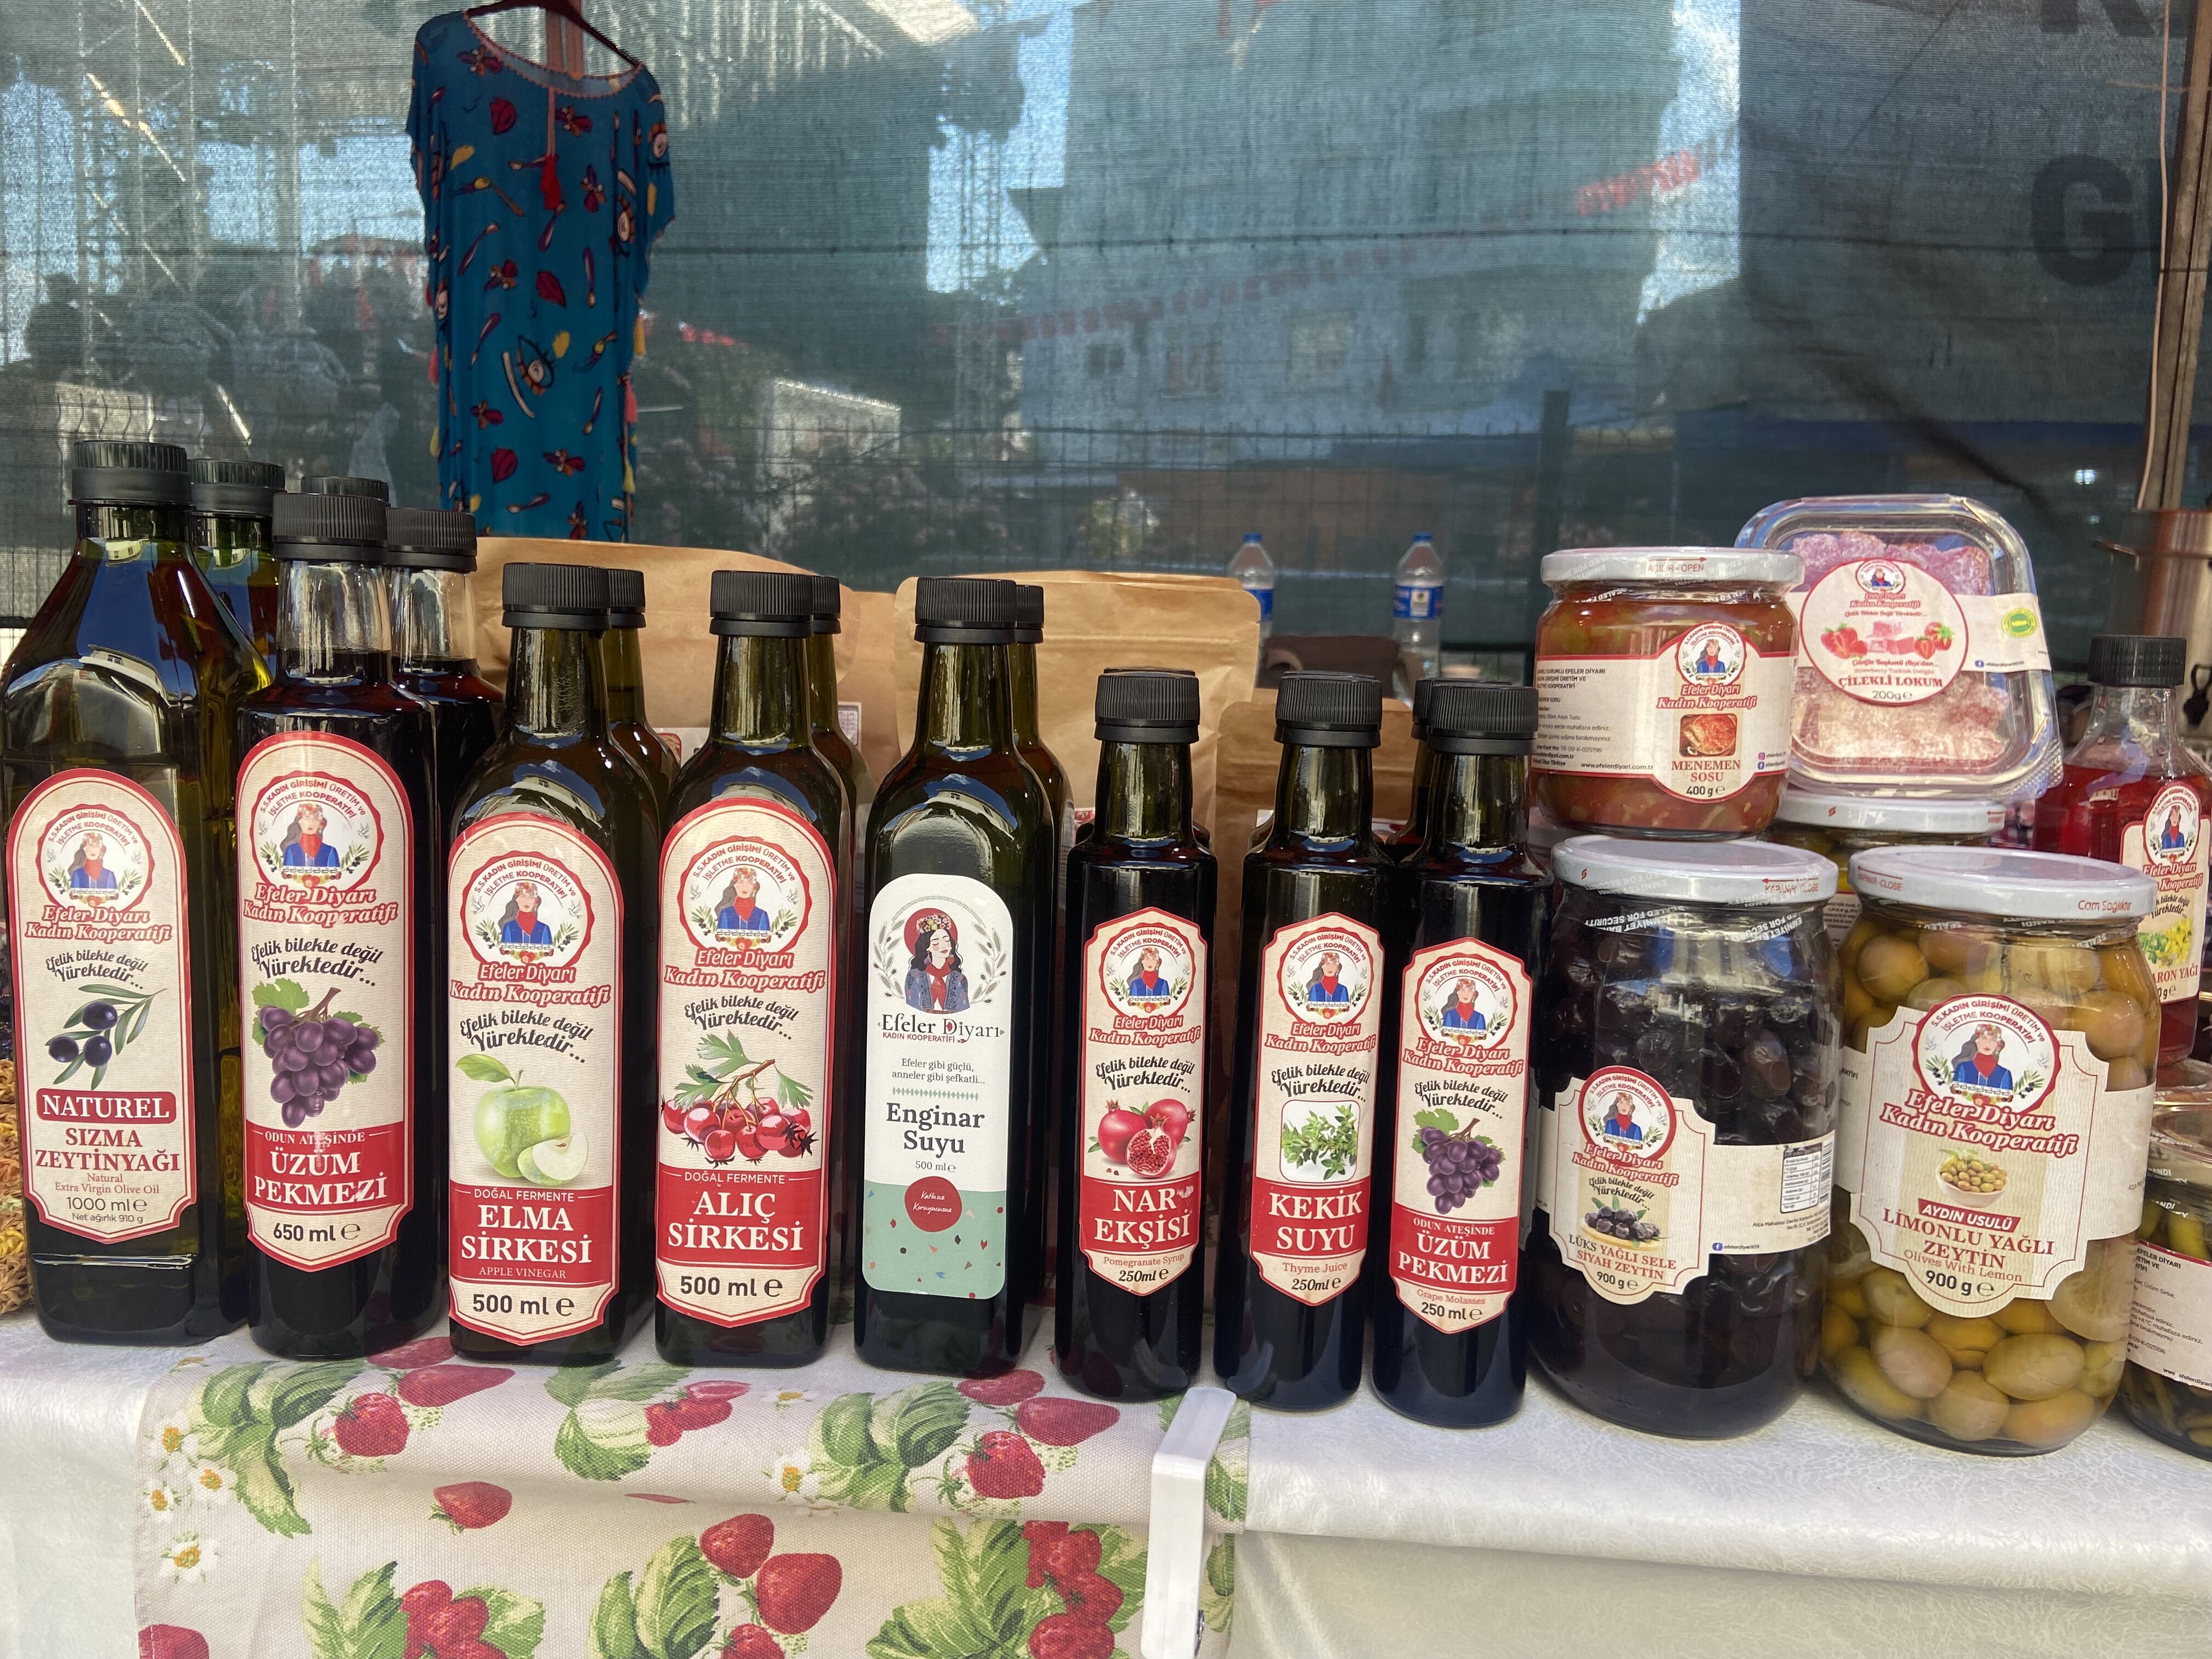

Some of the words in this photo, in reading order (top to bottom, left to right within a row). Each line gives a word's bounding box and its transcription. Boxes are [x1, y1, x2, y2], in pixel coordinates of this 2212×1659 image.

[1838, 675, 1892, 690] ÇİLEKLİ
[1896, 678, 1943, 687] LOKUM
[1671, 760, 1741, 771] MENEMEN
[1690, 772, 1724, 782] SOSU
[1686, 786, 1705, 795] 400
[2171, 862, 2197, 876] Diyarı
[2160, 873, 2203, 893] Kooperatifi
[42, 905, 92, 922] Efeler
[93, 906, 150, 926] Diyarı
[25, 922, 73, 939] Kadın
[75, 924, 172, 944] Kooperatifi
[46, 951, 74, 972] Efelik
[76, 950, 114, 961] bilekte
[116, 954, 149, 972] değil
[478, 961, 525, 981] Efeler
[526, 962, 576, 985] Diyarı
[2179, 963, 2198, 981] YAĞI
[450, 980, 503, 1002] Kadın
[504, 984, 612, 1008] Kooperatifi
[882, 1013, 936, 1034] Efeler
[943, 1018, 1000, 1042] Diyarı
[1114, 1015, 1148, 1030] Efeler
[1149, 1015, 1183, 1032] Diyarı
[1942, 1012, 1978, 1032] İŞLETME
[1980, 1011, 2036, 1044] KOOPERATİFİ
[1971, 1000, 2011, 1012] GİRİŞİMİ
[2011, 1007, 2041, 1034] ÜRETİM
[883, 1032, 905, 1040] KADIN
[907, 1034, 955, 1043] KOOPERATİFİ
[1089, 1028, 1131, 1045] Kadın
[1132, 1025, 1201, 1048] Kooperatifi
[901, 1058, 927, 1068] Efeler
[928, 1059, 945, 1070] gibi
[947, 1060, 974, 1073] güçlü,
[891, 1071, 926, 1081] anneler
[927, 1071, 944, 1083] gibi
[42, 1094, 170, 1119] NATUREL
[886, 1102, 985, 1131] Enginar
[1905, 1088, 1978, 1118] Efeler
[1979, 1104, 2056, 1131] Diyarı
[65, 1127, 143, 1148] SIZMA
[265, 1131, 295, 1144] ODUN
[299, 1131, 365, 1147] ATŞİNDE
[1880, 1103, 1947, 1137] Kadın
[1949, 1121, 2080, 1157] Kooperatifi
[904, 1130, 966, 1159] Suyu
[35, 1149, 180, 1172] ZEYTİNYAĞI
[915, 1161, 933, 1170] 500
[87, 1173, 123, 1183] Natural
[685, 1170, 724, 1182] DOĞAL
[727, 1173, 785, 1184] FERMENTE
[55, 1183, 78, 1193] Extra
[81, 1183, 111, 1195] Virgin
[114, 1184, 141, 1194] Olive
[143, 1184, 159, 1194] Oil
[255, 1172, 387, 1205] PEKMEZİ
[475, 1187, 513, 1200] DOĞAL
[516, 1191, 574, 1202] FERMENTE
[66, 1197, 106, 1211] 1000
[693, 1190, 775, 1224] ALIÇ
[913, 1202, 952, 1214] Koruyucusuz
[1113, 1188, 1177, 1213] NAR
[1268, 1189, 1362, 1220] KEKİK
[72, 1212, 84, 1221] Net
[87, 1212, 116, 1223] ağırlık
[119, 1214, 135, 1222] 910
[478, 1204, 574, 1231] ELMA
[1413, 1217, 1441, 1231] ODUN
[1444, 1224, 1495, 1237] ATEŞİNDE
[1921, 1203, 1965, 1224] AYDIN
[1966, 1211, 2013, 1231] USULÜ
[273, 1222, 303, 1241] 650
[309, 1225, 336, 1242] ml
[668, 1217, 804, 1251] SİRKESİ
[1094, 1209, 1190, 1250] EKŞİSİ
[1277, 1224, 1355, 1251] SUYU
[1882, 1208, 1983, 1246] LİMONLU
[1989, 1233, 2055, 1255] YAĞLI
[461, 1231, 592, 1263] SİRKESİ
[1417, 1230, 1491, 1260] ÜZÜM
[1568, 1233, 1596, 1252] LÜKS
[1599, 1244, 1639, 1263] YAĞLI
[1641, 1255, 1677, 1271] SELE
[1922, 1239, 2006, 1270] ZEYTİN
[1104, 1256, 1161, 1268] Pomegranate
[1163, 1253, 1184, 1264] Syrup
[1282, 1262, 1321, 1273] Thyme
[1323, 1263, 1347, 1273] Juice
[1398, 1250, 1508, 1284] PEKMEZİ
[1576, 1248, 1612, 1270] SİYAH
[1615, 1260, 1665, 1280] ZEYTİN
[1904, 1249, 1942, 1268] Olives
[1945, 1259, 1978, 1275] With
[1979, 1265, 2023, 1283] Lemon
[2137, 1248, 2157, 1261] EFELER
[2159, 1256, 2181, 1269] DİYARI
[479, 1267, 513, 1277] APPLE
[516, 1268, 566, 1279] VINEGAR
[1596, 1271, 1616, 1285] 900
[1618, 1279, 1625, 1289] g
[1925, 1269, 1957, 1289] 900
[1960, 1280, 1972, 1296] g
[680, 1276, 720, 1295] 500
[728, 1278, 757, 1296] ml
[473, 1294, 512, 1313] 500
[521, 1296, 549, 1315] ml
[1417, 1289, 1443, 1301] Grape
[1446, 1295, 1486, 1305] Molasses
[1421, 1301, 1444, 1318] 250
[1448, 1308, 1466, 1320] ml
